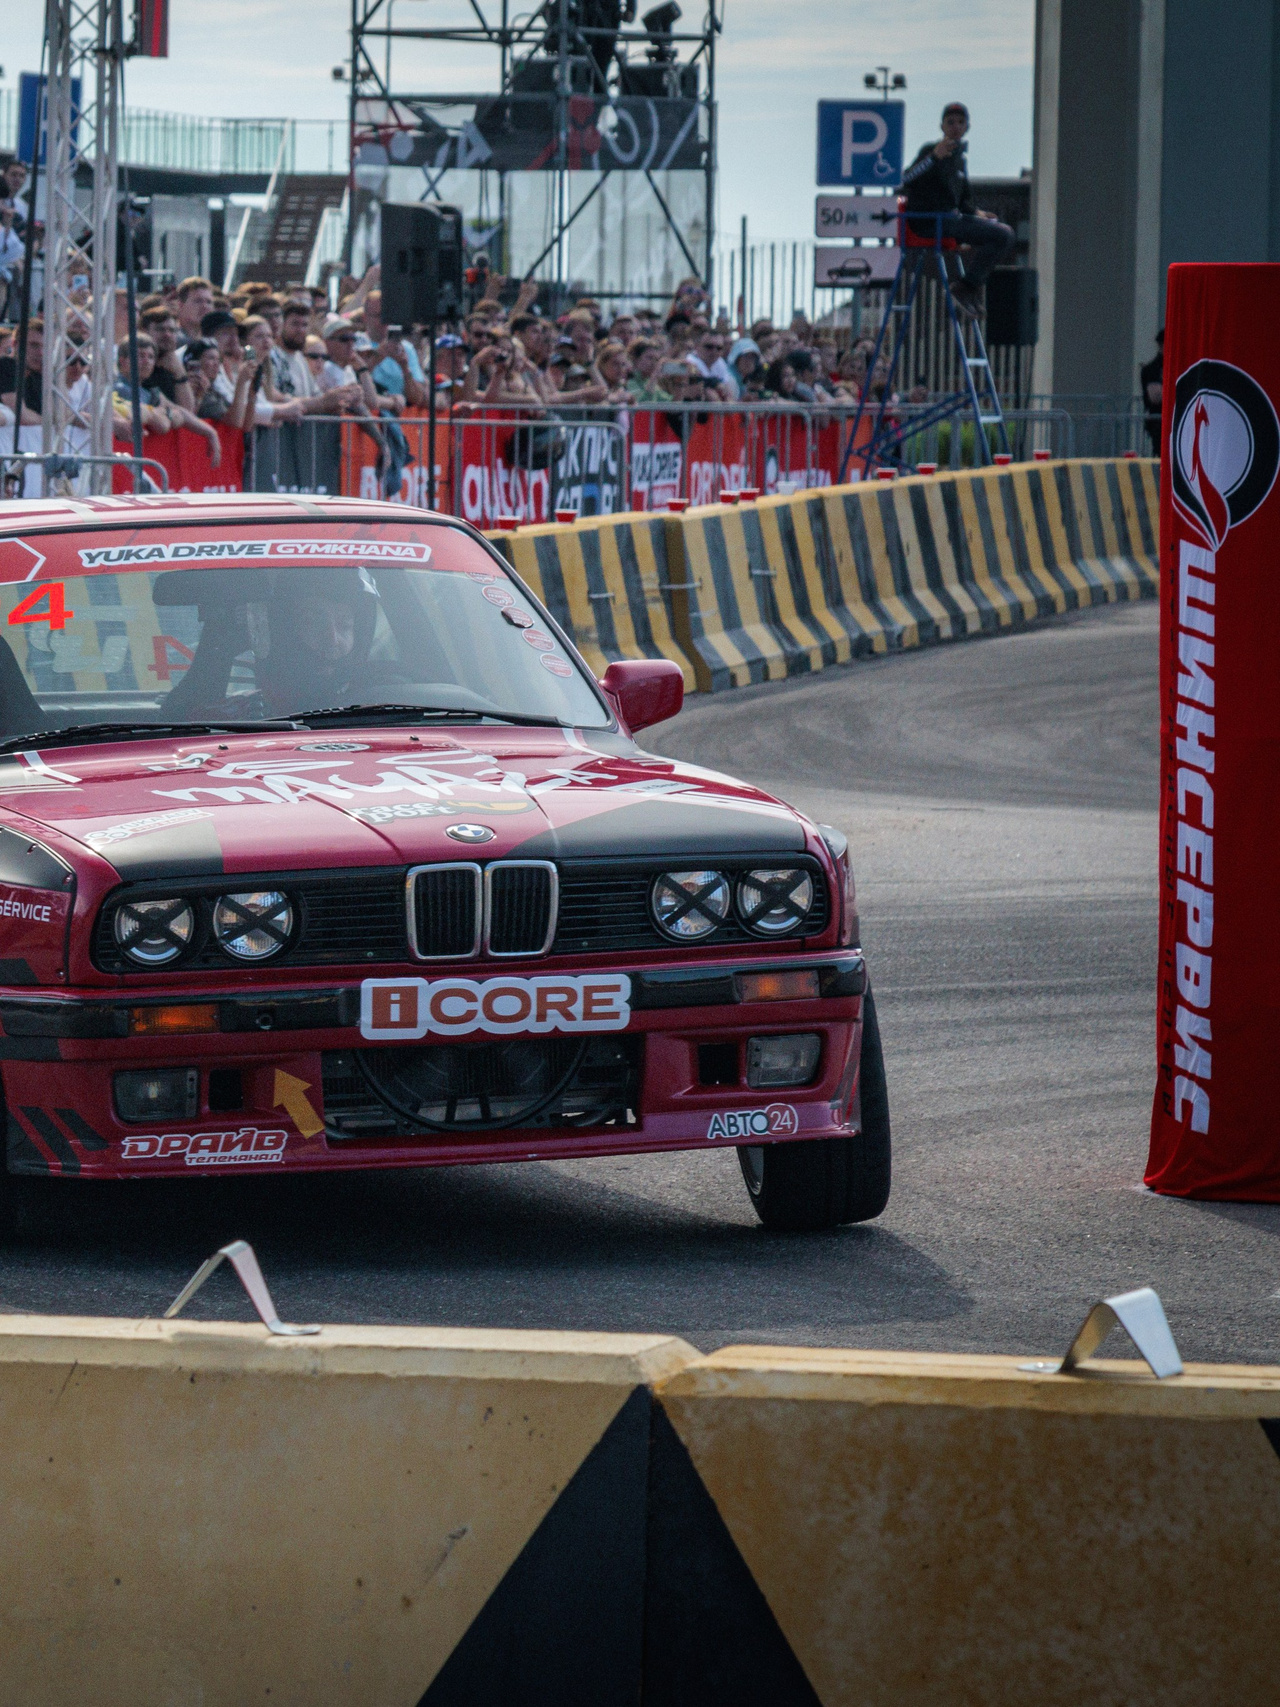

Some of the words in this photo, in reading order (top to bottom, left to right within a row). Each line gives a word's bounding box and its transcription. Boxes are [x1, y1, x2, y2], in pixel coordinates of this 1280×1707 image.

[841, 110, 888, 178] P
[821, 208, 843, 226] 50
[83, 546, 163, 564] YUKA
[172, 543, 266, 559] DRIVE
[275, 543, 417, 558] GYMKHANA
[1173, 539, 1216, 1135] ШИНСЕРВИС
